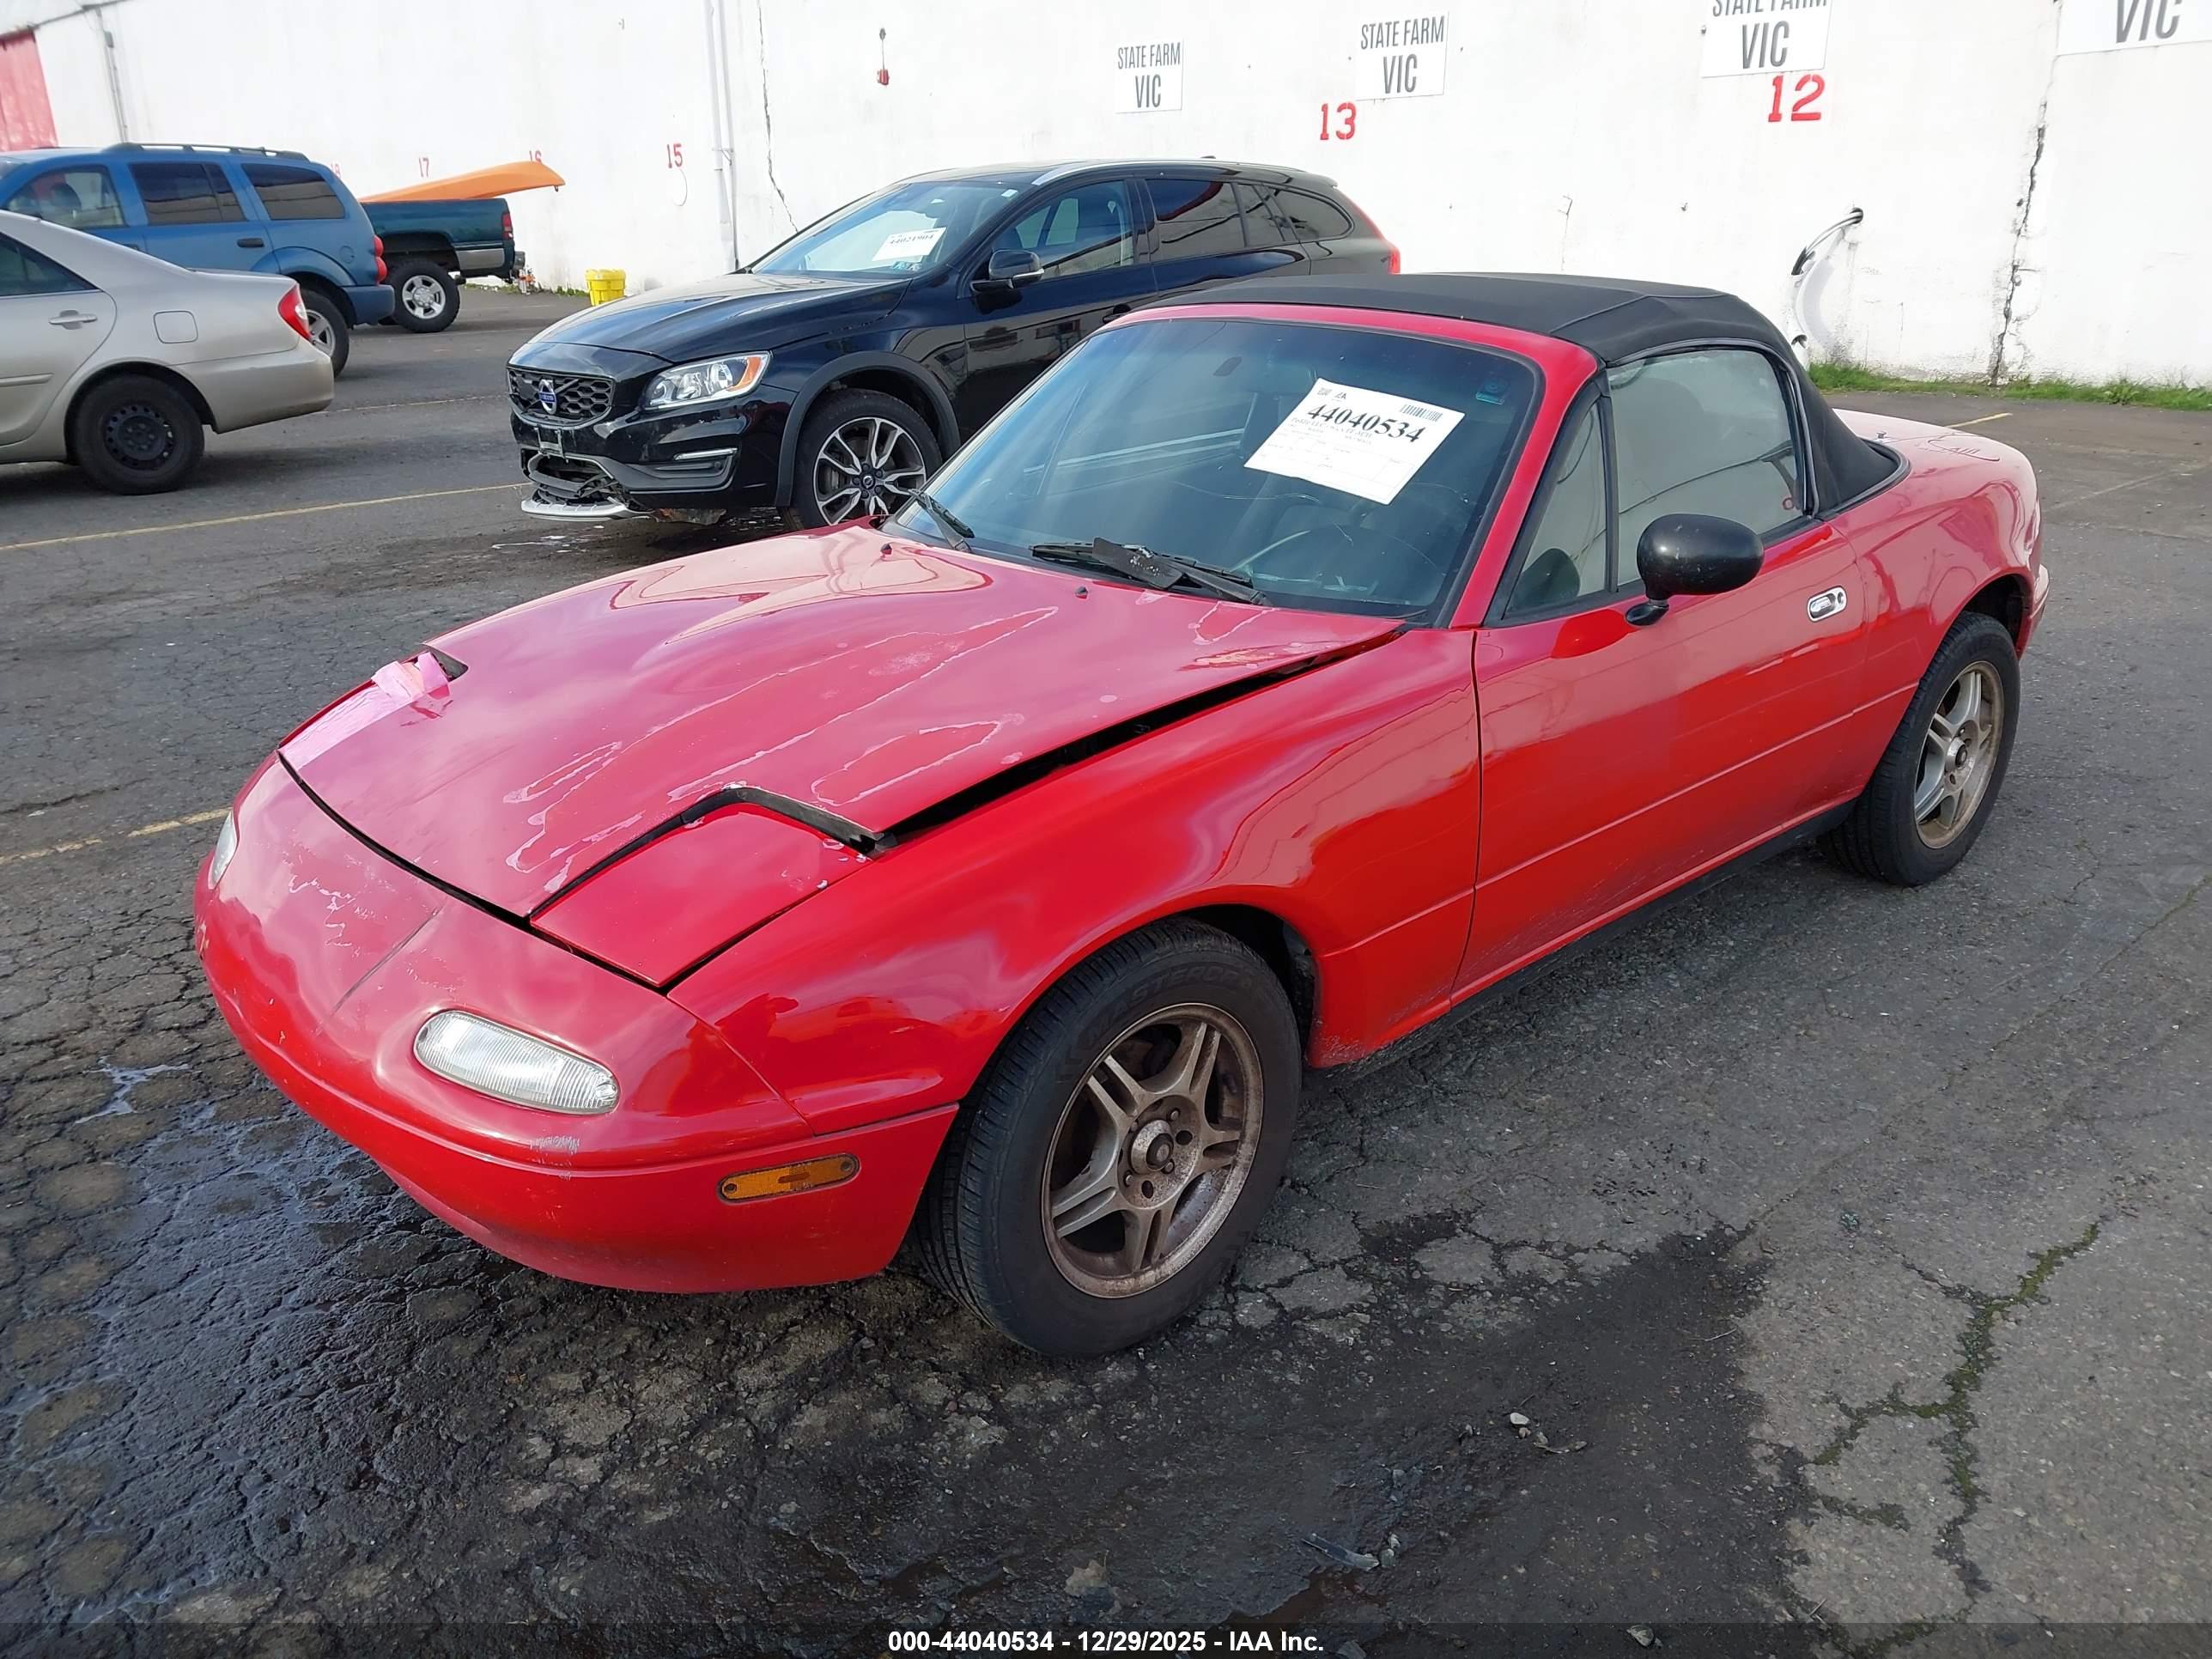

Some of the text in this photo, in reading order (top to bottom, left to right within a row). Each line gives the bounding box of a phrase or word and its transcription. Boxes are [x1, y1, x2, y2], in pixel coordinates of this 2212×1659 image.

[1360, 15, 1444, 50] STATE FARM
[2116, 0, 2183, 44] VIC
[1117, 42, 1181, 70] STATE FARM
[1742, 21, 1790, 69] VIC
[1134, 74, 1161, 108] VIC
[1382, 53, 1418, 94] VIC
[1768, 74, 1826, 122] 12
[1320, 102, 1357, 140] 13
[418, 157, 430, 178] 17
[666, 143, 683, 169] 15
[1307, 404, 1426, 443] 44040534
